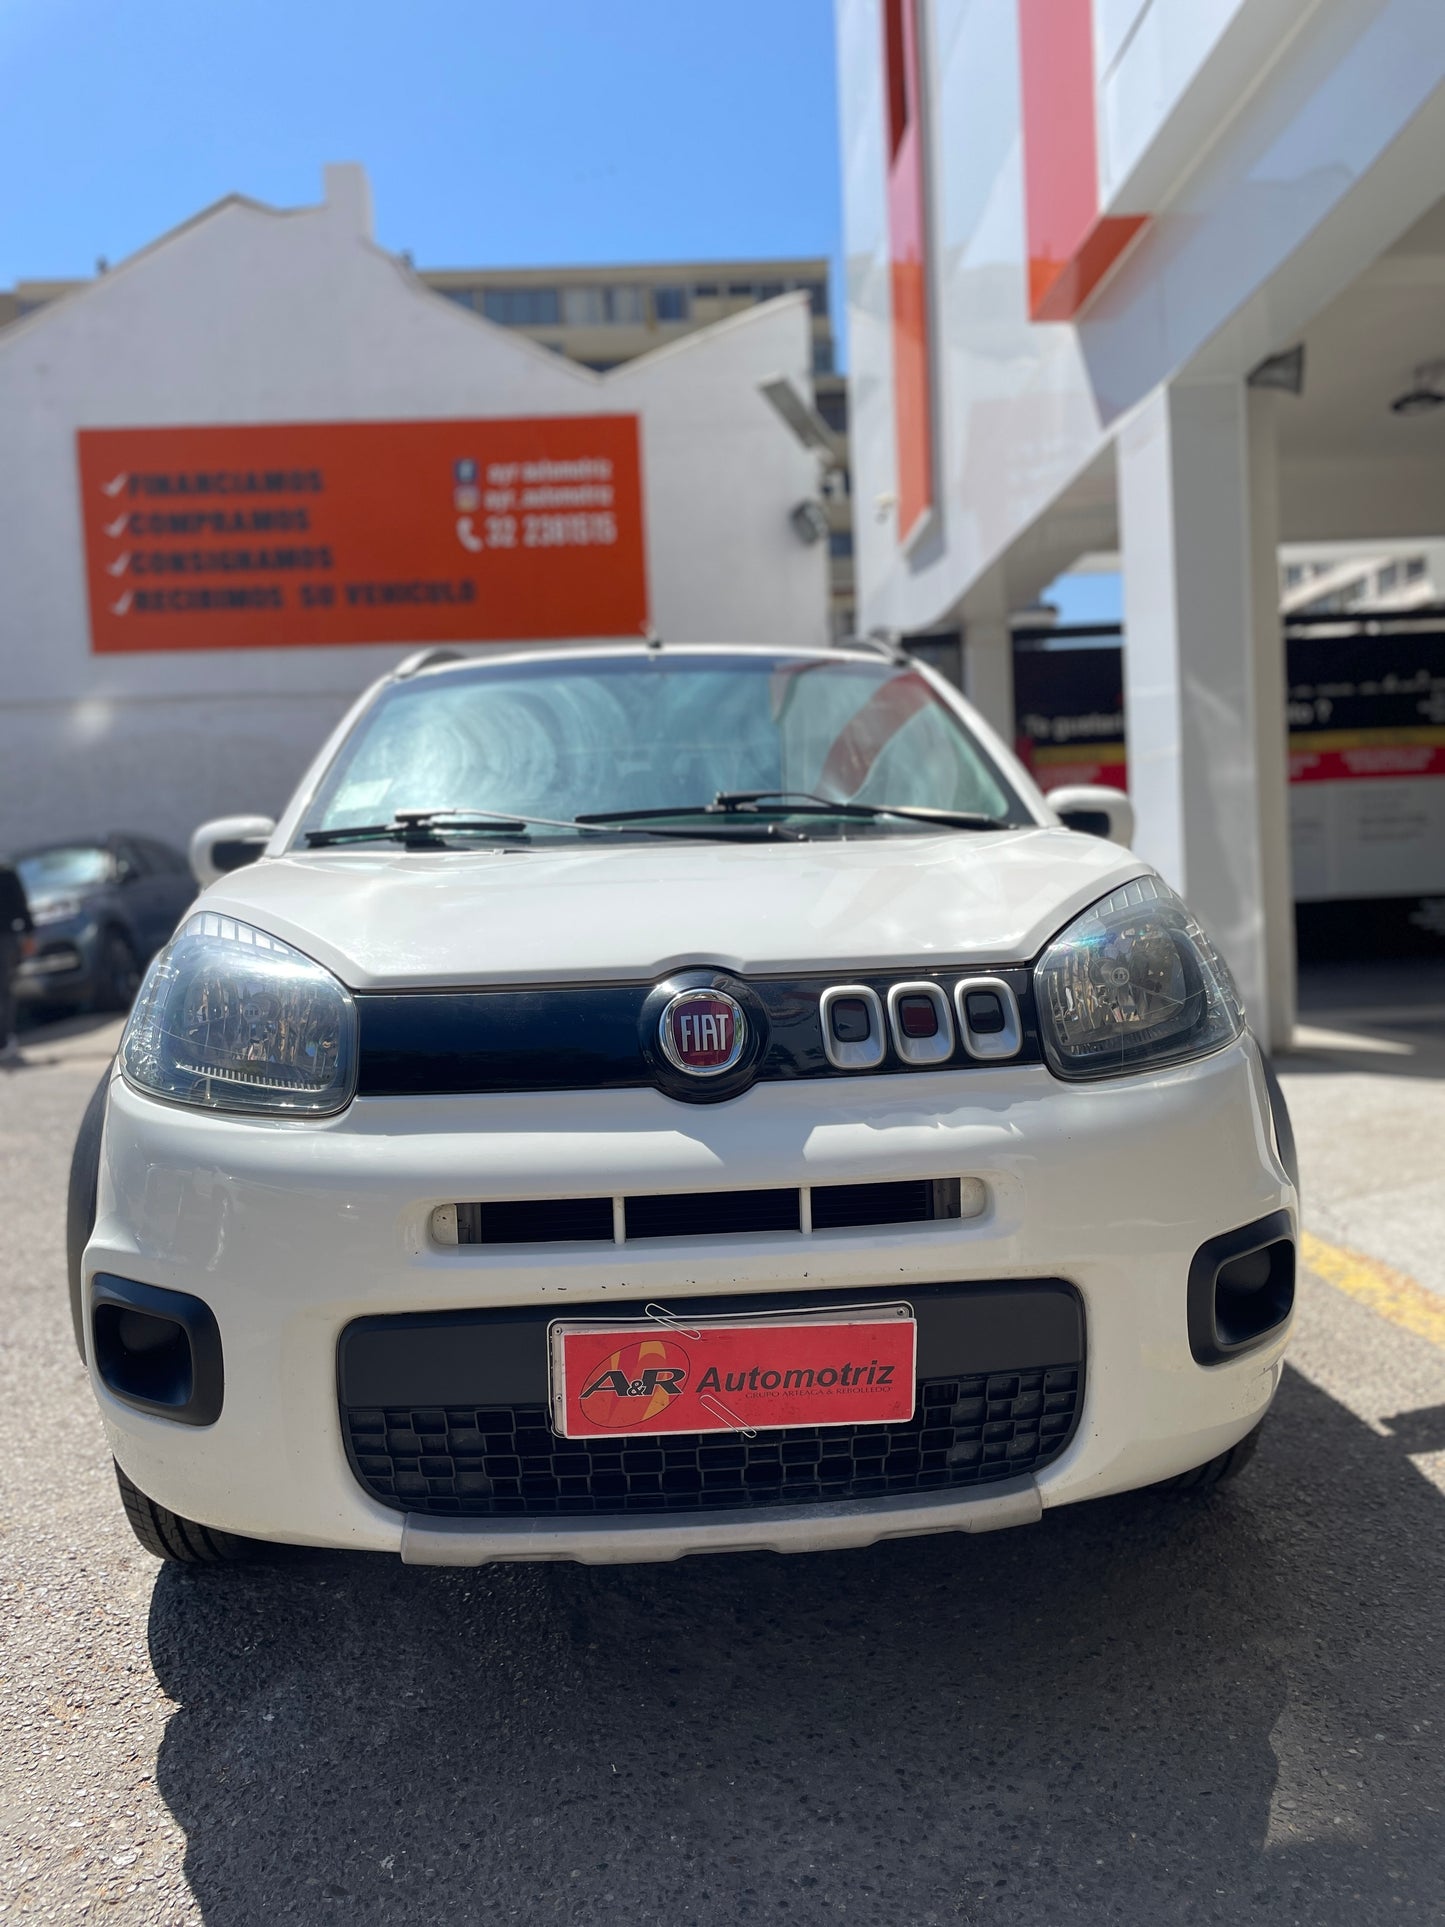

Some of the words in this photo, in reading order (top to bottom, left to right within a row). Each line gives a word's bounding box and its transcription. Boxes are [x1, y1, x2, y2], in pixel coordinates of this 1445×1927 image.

[129, 471, 323, 496] FINANCIAMOS
[131, 509, 309, 536] COMPRAMOS
[132, 547, 332, 577] CONSIGNAMOS
[135, 585, 283, 612] RECIBIMOS
[301, 583, 336, 608] SU
[680, 1014, 729, 1052] FIAT
[578, 1368, 686, 1399] A&R
[695, 1360, 896, 1393] Automotriz
[745, 1391, 780, 1399] GRUPO
[782, 1389, 824, 1397] ARTEAGA
